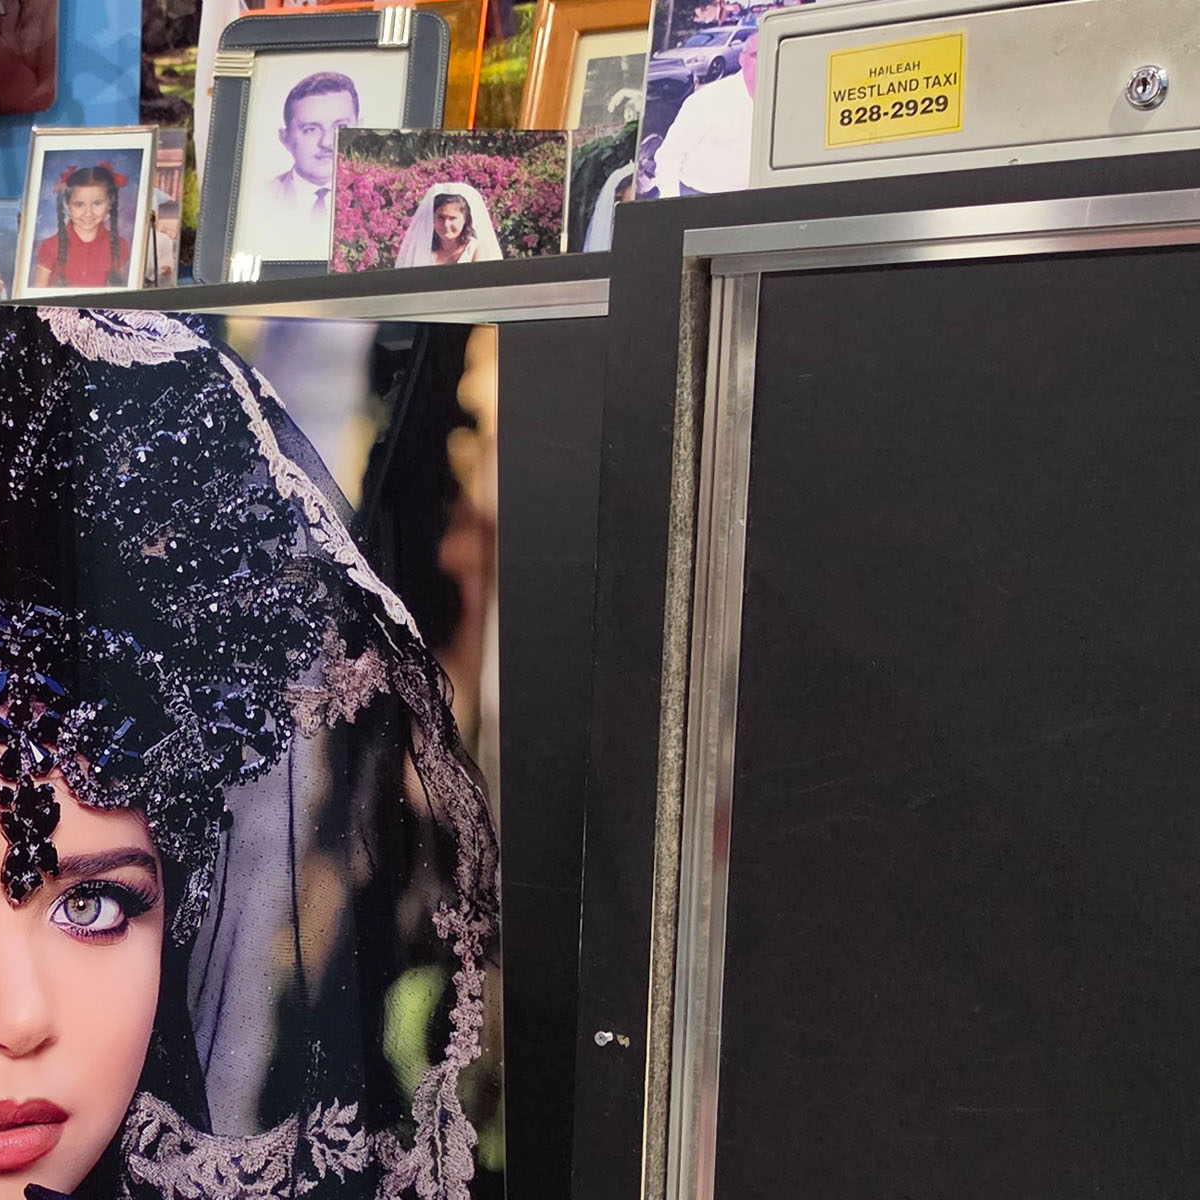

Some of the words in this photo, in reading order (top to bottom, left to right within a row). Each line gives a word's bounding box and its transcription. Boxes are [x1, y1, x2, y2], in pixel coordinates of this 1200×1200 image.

[869, 61, 920, 77] HAILEAH
[833, 78, 919, 103] WESTLAND
[923, 72, 957, 89] TAXI
[840, 94, 949, 126] 828-2929
